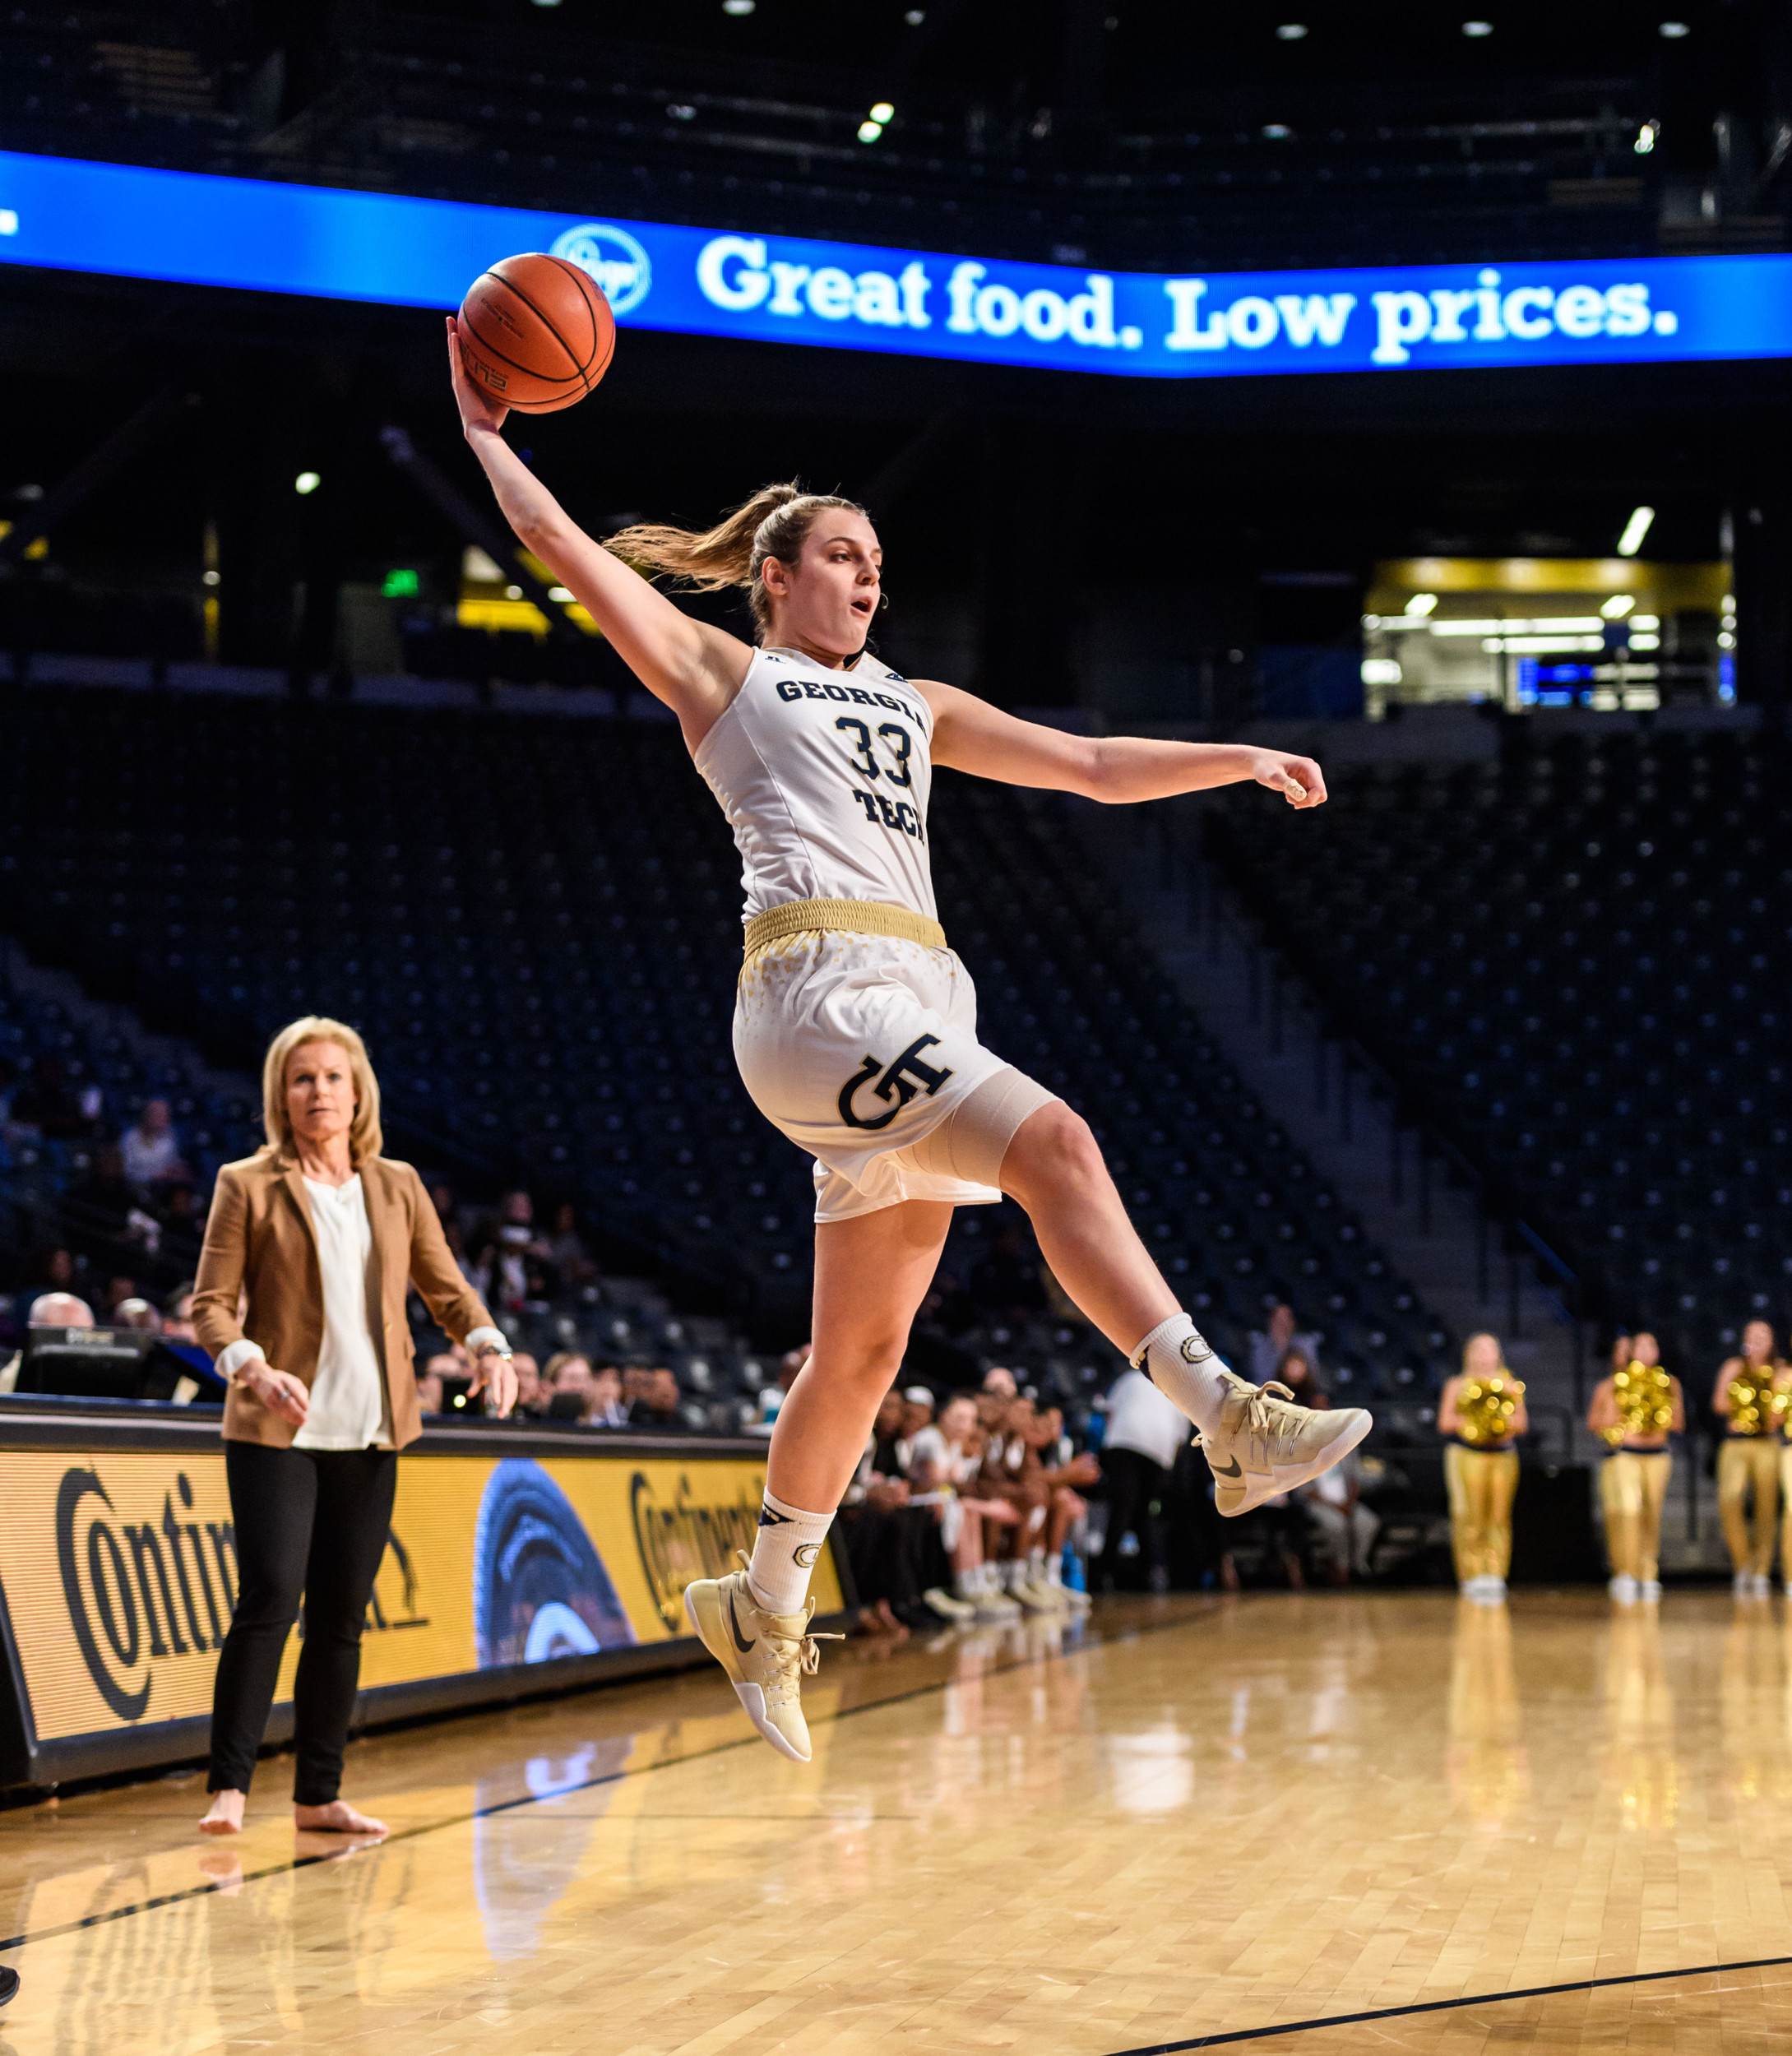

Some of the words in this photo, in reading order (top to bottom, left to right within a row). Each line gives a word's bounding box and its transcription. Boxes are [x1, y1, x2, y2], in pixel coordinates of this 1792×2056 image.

[697, 236, 931, 328] Great
[946, 261, 1143, 350] food.
[1164, 279, 1357, 351] Low
[1371, 268, 1678, 365] prices.
[835, 715, 912, 789] 33
[836, 1031, 956, 1132] GT
